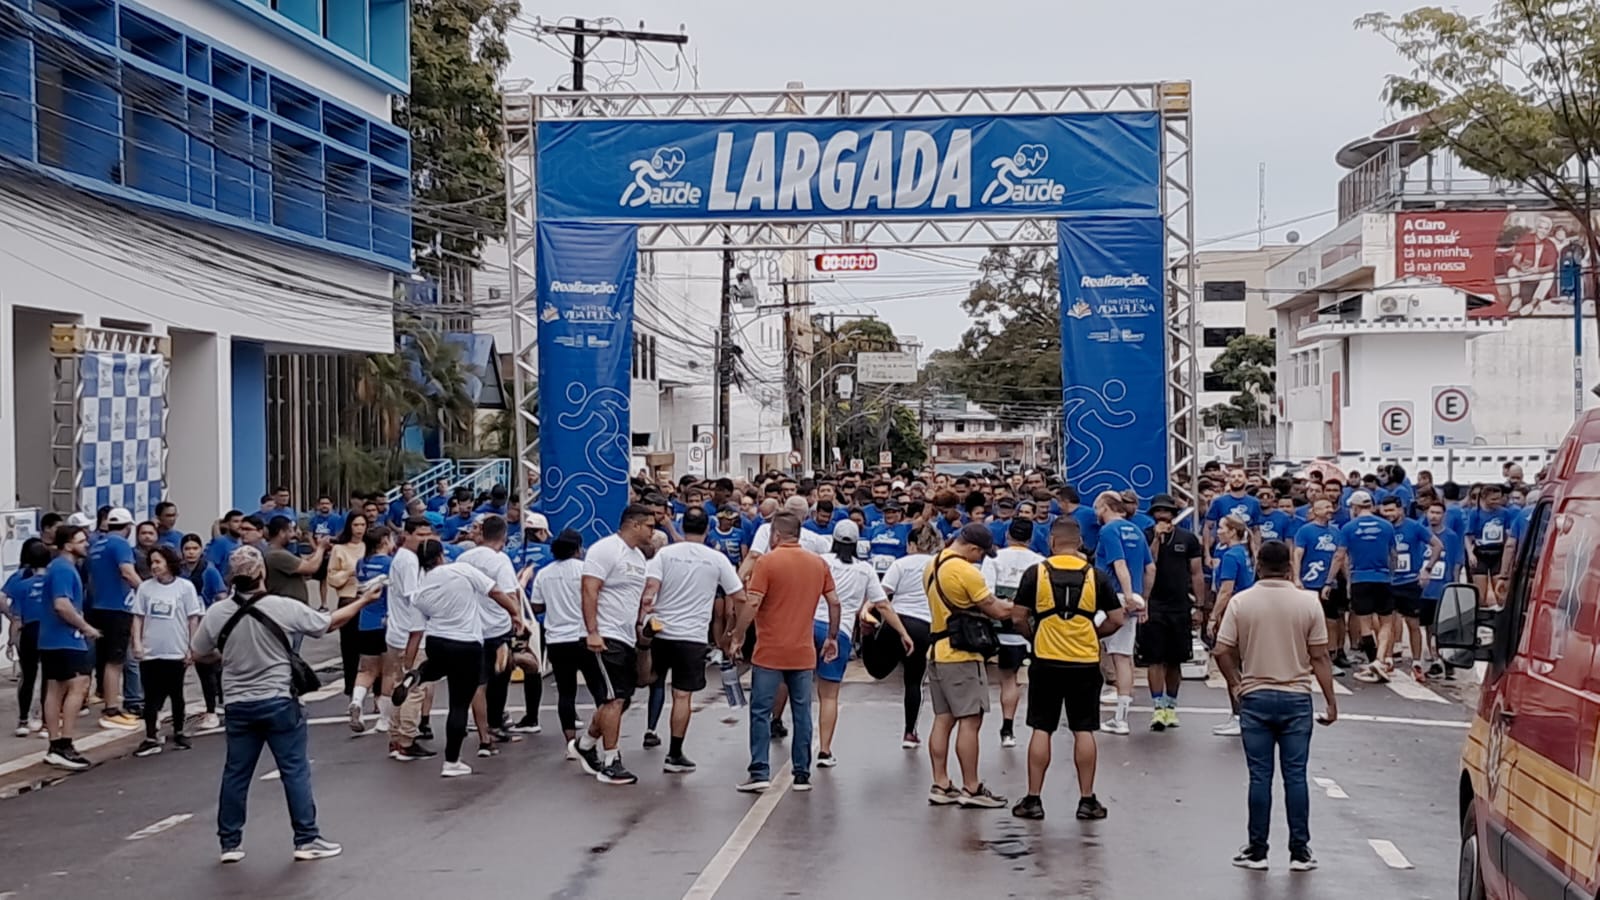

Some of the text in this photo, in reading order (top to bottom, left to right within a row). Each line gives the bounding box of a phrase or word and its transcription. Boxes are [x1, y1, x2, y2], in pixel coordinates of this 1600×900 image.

[708, 129, 972, 211] LARGADA
[1403, 219, 1446, 231] A Claro
[1404, 232, 1416, 244] tá
[1418, 235, 1433, 244] na
[1404, 246, 1473, 259] tá na minha,
[821, 255, 875, 270] 00:00:00
[1404, 260, 1466, 272] tá na nossa
[1446, 396, 1458, 415] E
[1391, 412, 1402, 431] E
